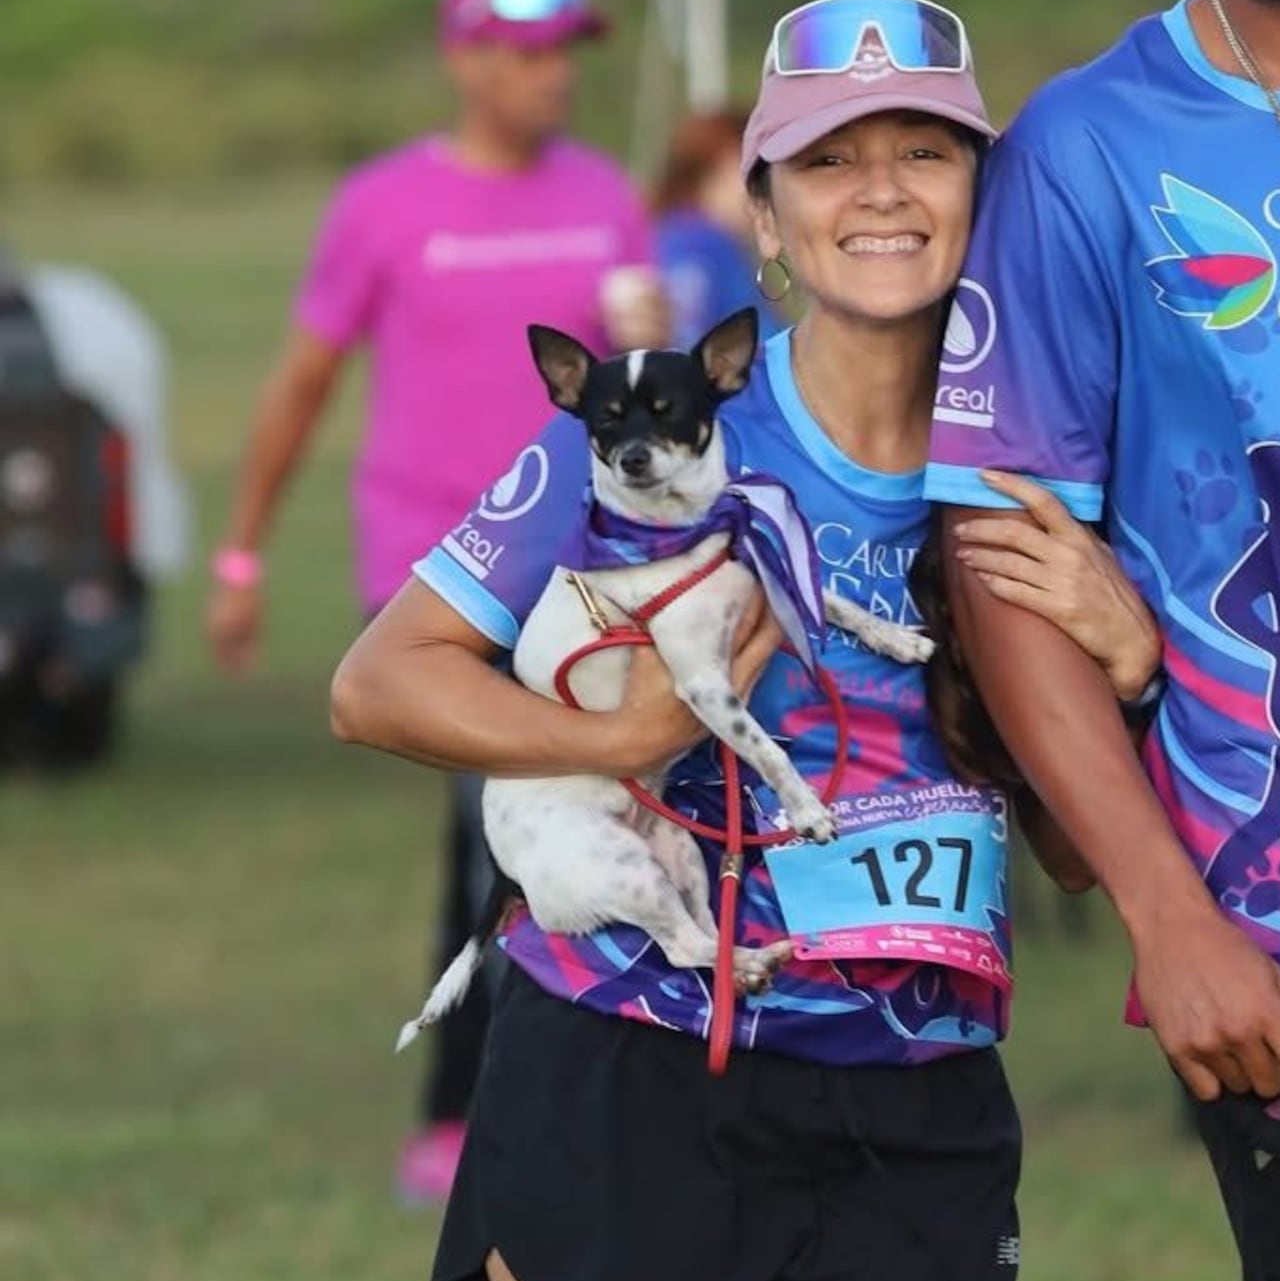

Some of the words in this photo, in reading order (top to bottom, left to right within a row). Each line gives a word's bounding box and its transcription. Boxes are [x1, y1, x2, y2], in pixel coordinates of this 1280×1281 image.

[855, 795, 907, 811] CADA
[910, 783, 982, 805] HUELLA
[850, 837, 973, 913] 127
